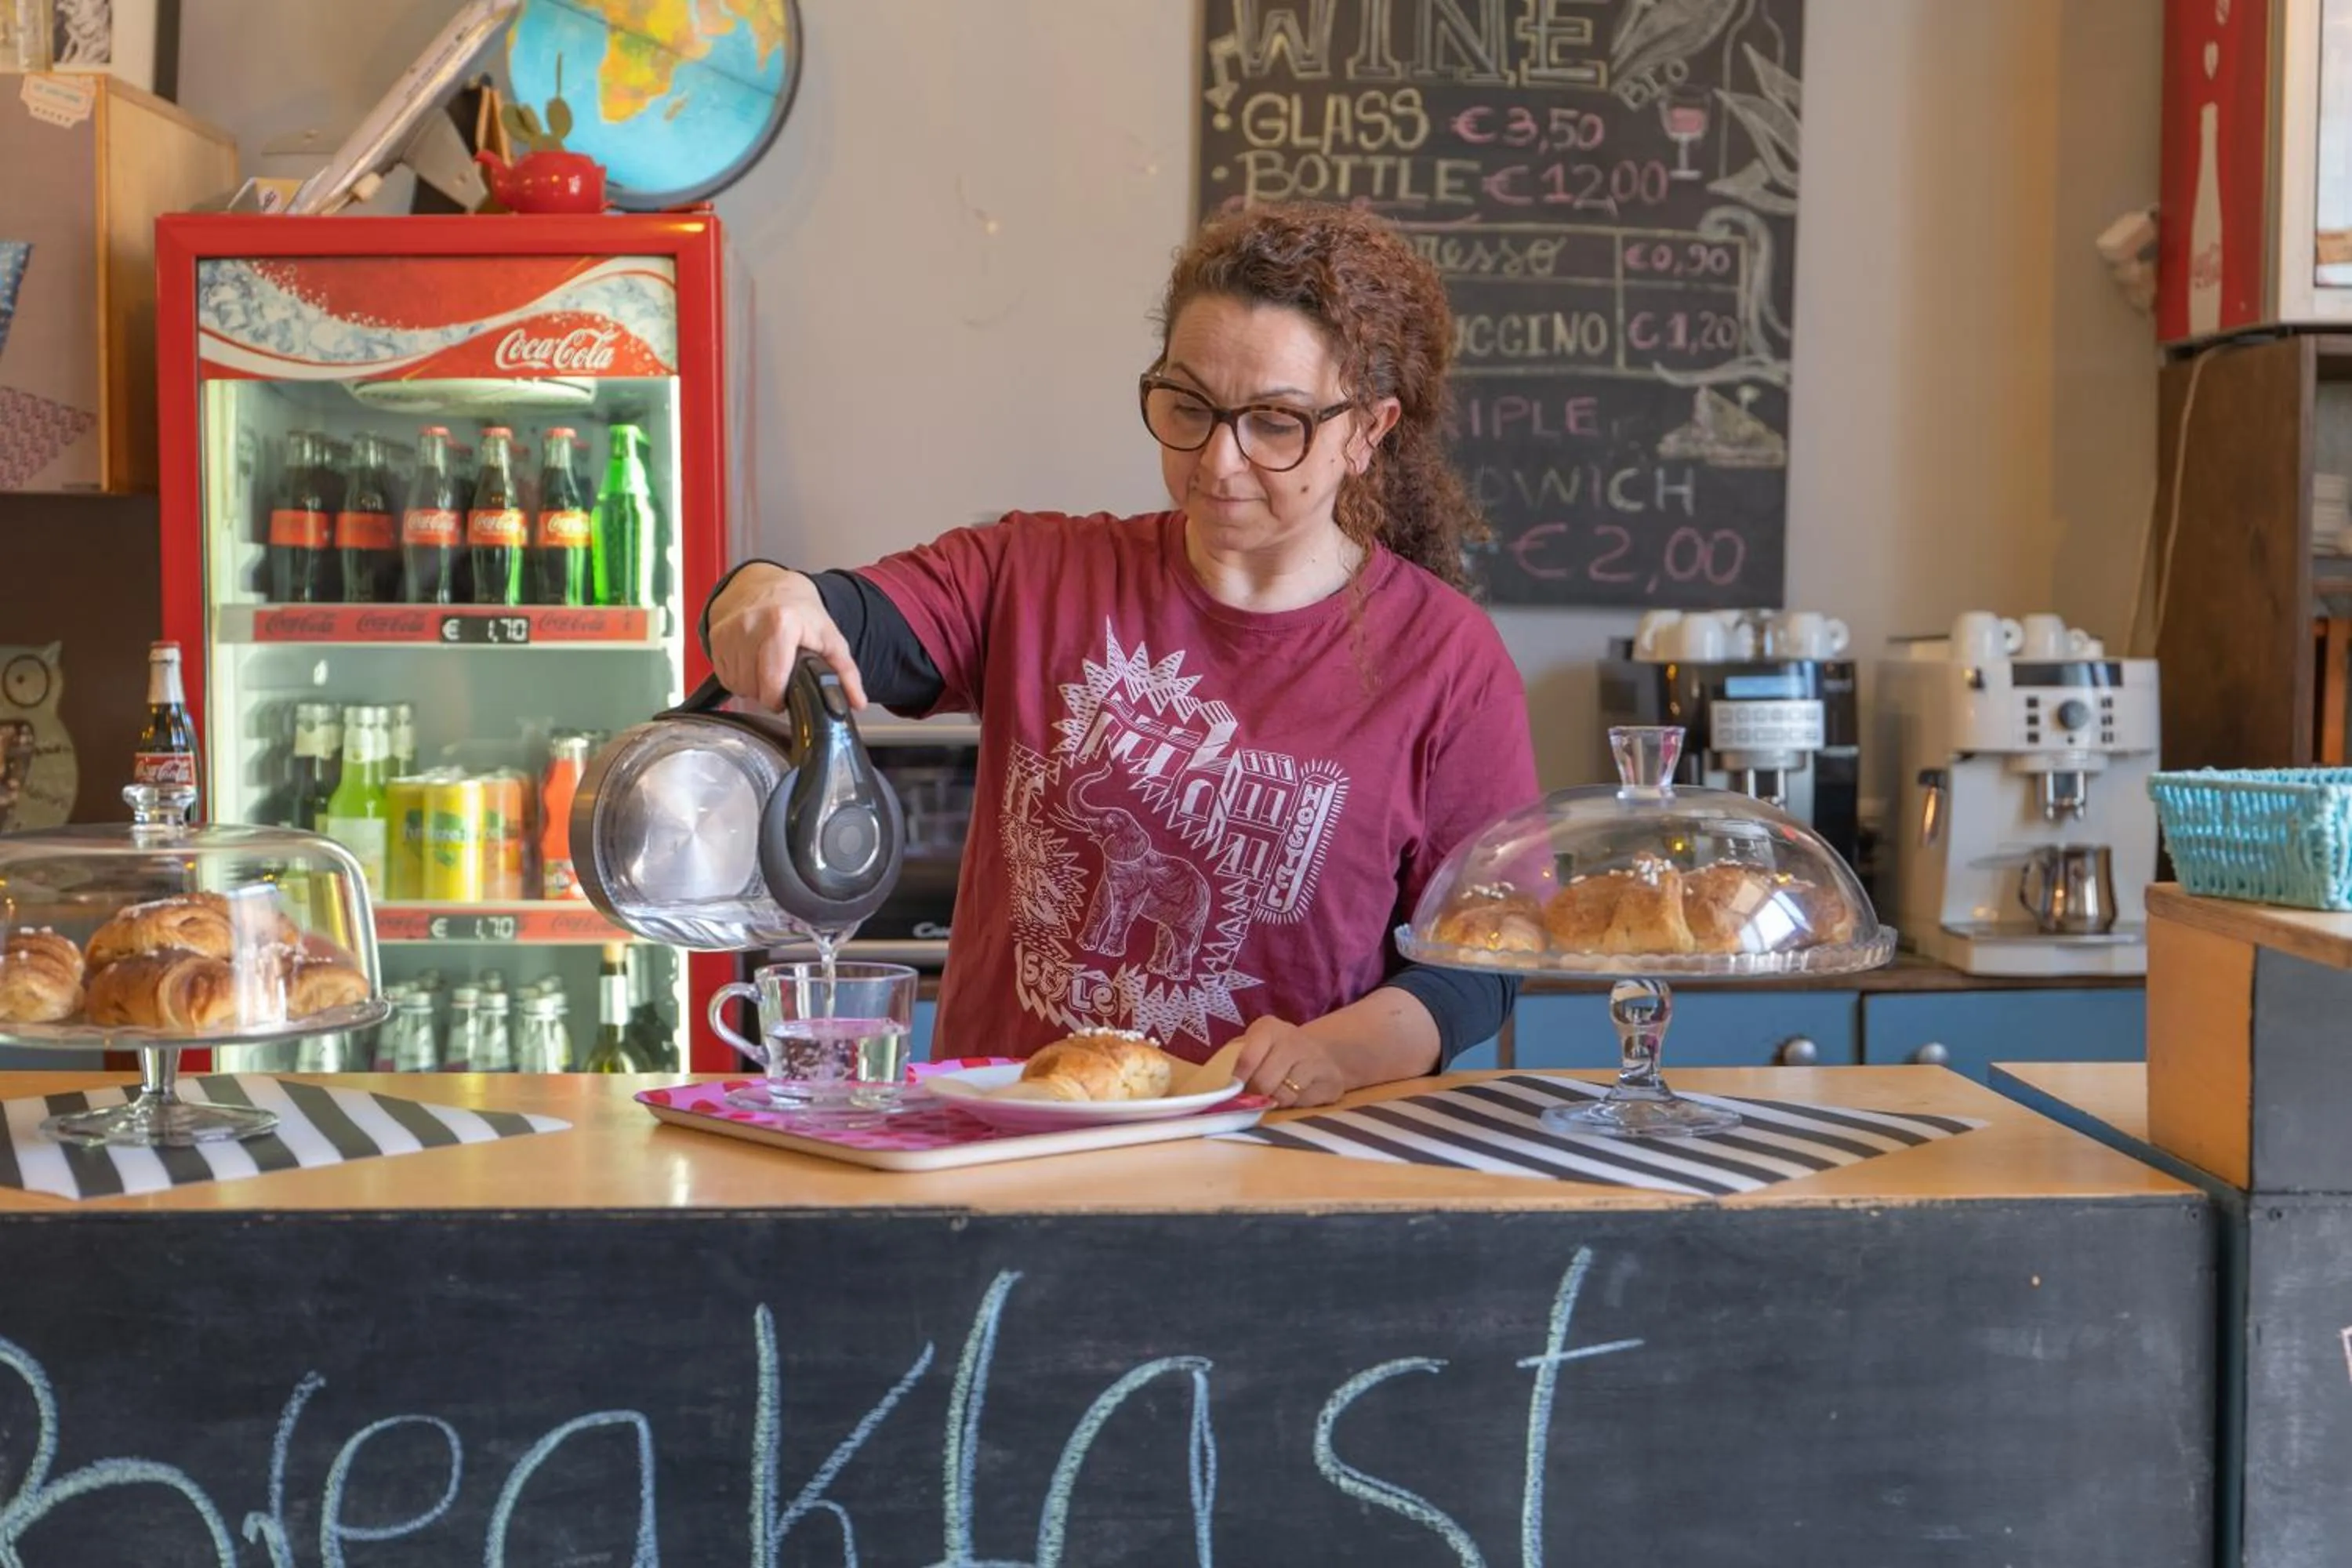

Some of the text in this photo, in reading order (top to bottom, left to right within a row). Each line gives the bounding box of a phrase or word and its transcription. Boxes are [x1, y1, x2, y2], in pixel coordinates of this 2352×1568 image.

[1235, 0, 1606, 89] WINE
[1242, 88, 1430, 154] GLASS
[1236, 151, 1480, 208] BOTTLE
[495, 328, 622, 371] Coca-Cola
[441, 618, 529, 643] € 1,70
[474, 916, 515, 941] 1,70
